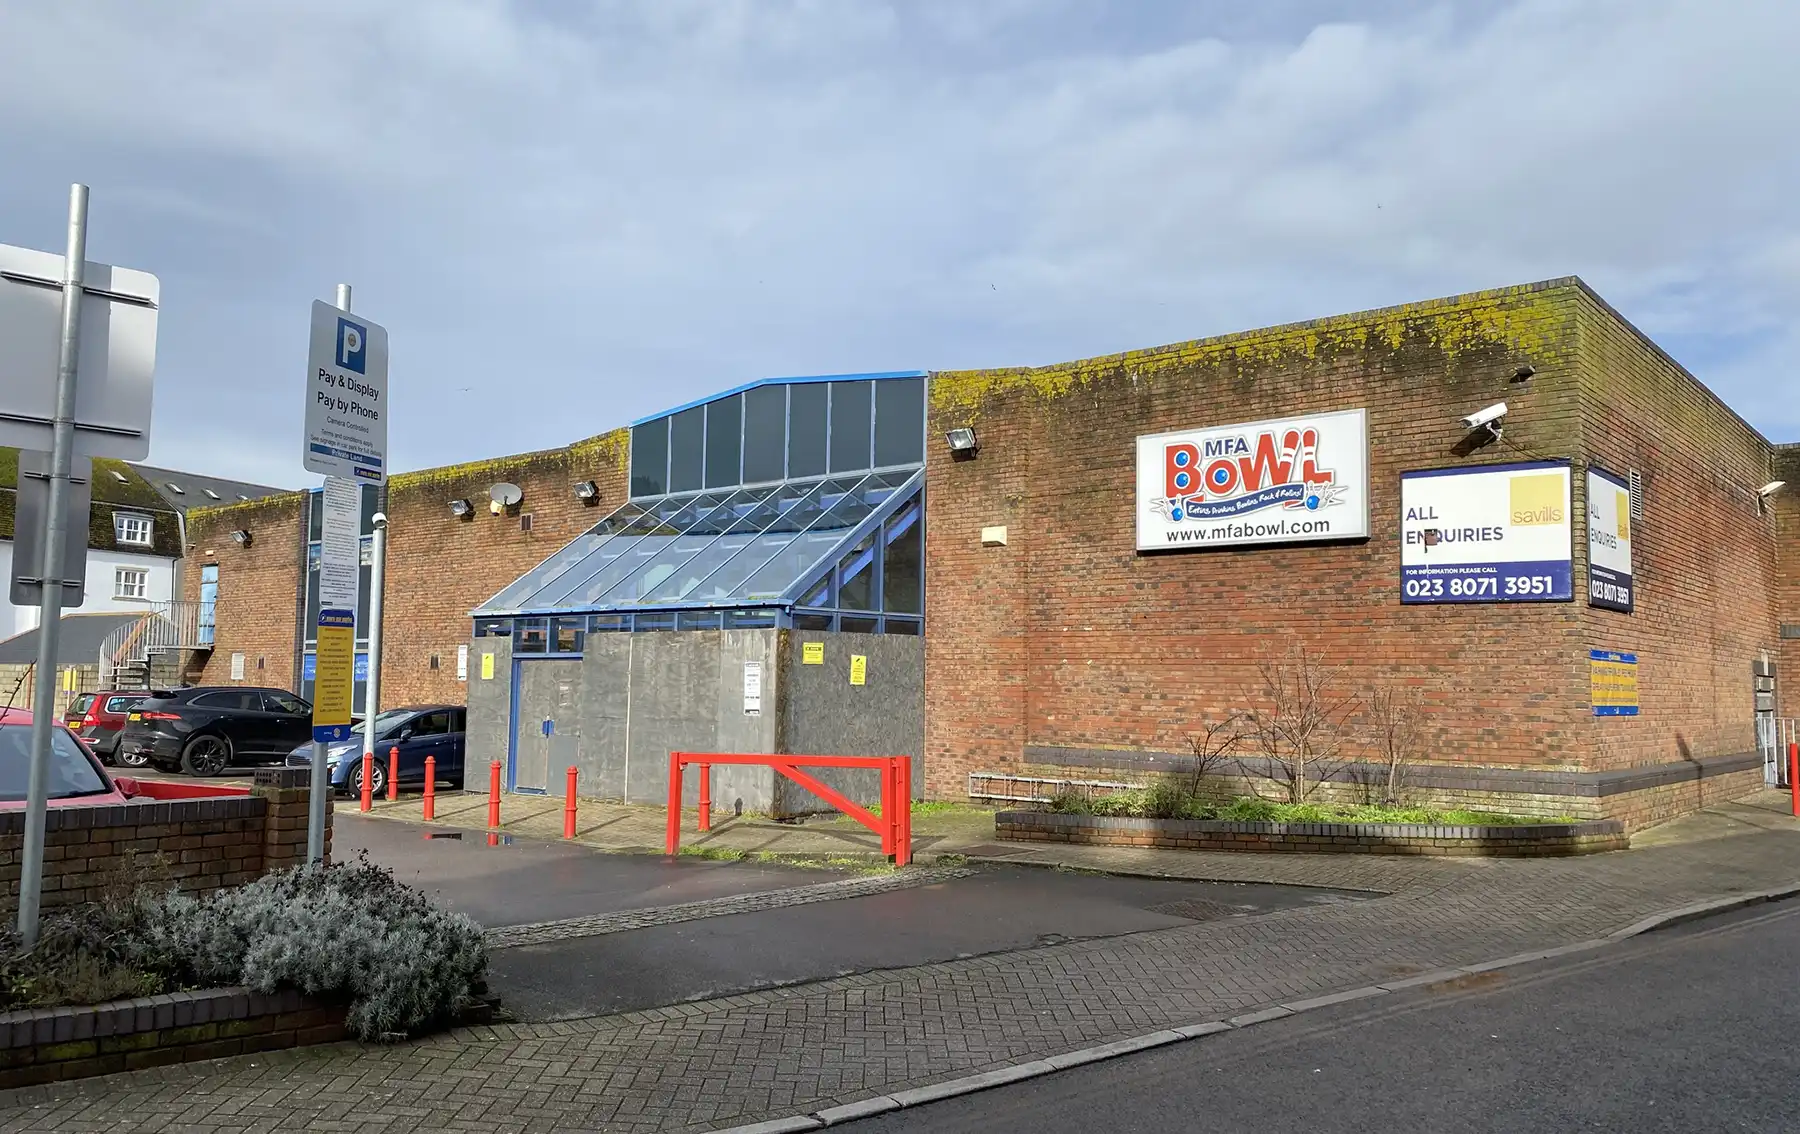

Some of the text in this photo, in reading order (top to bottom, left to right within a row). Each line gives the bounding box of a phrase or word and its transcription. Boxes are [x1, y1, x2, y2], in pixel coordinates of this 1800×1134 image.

[343, 325, 361, 364] P
[319, 368, 379, 401] Pay & Display
[317, 391, 379, 420] Pay by Phone
[321, 428, 334, 437] Terms
[326, 415, 369, 433] Camera Controlled
[331, 448, 349, 460] Private
[350, 451, 363, 462] Land
[1205, 436, 1249, 457] MFA
[1165, 429, 1332, 499] BOWL
[1259, 491, 1275, 502] Rock
[1406, 506, 1439, 521] ALL
[1513, 506, 1562, 524] savills
[1166, 519, 1330, 542] www.mfabowl.com
[1591, 527, 1617, 550] ENQUIRIES
[1406, 575, 1553, 597] 023 8071 3951
[1592, 579, 1629, 605] 023 8071 3951
